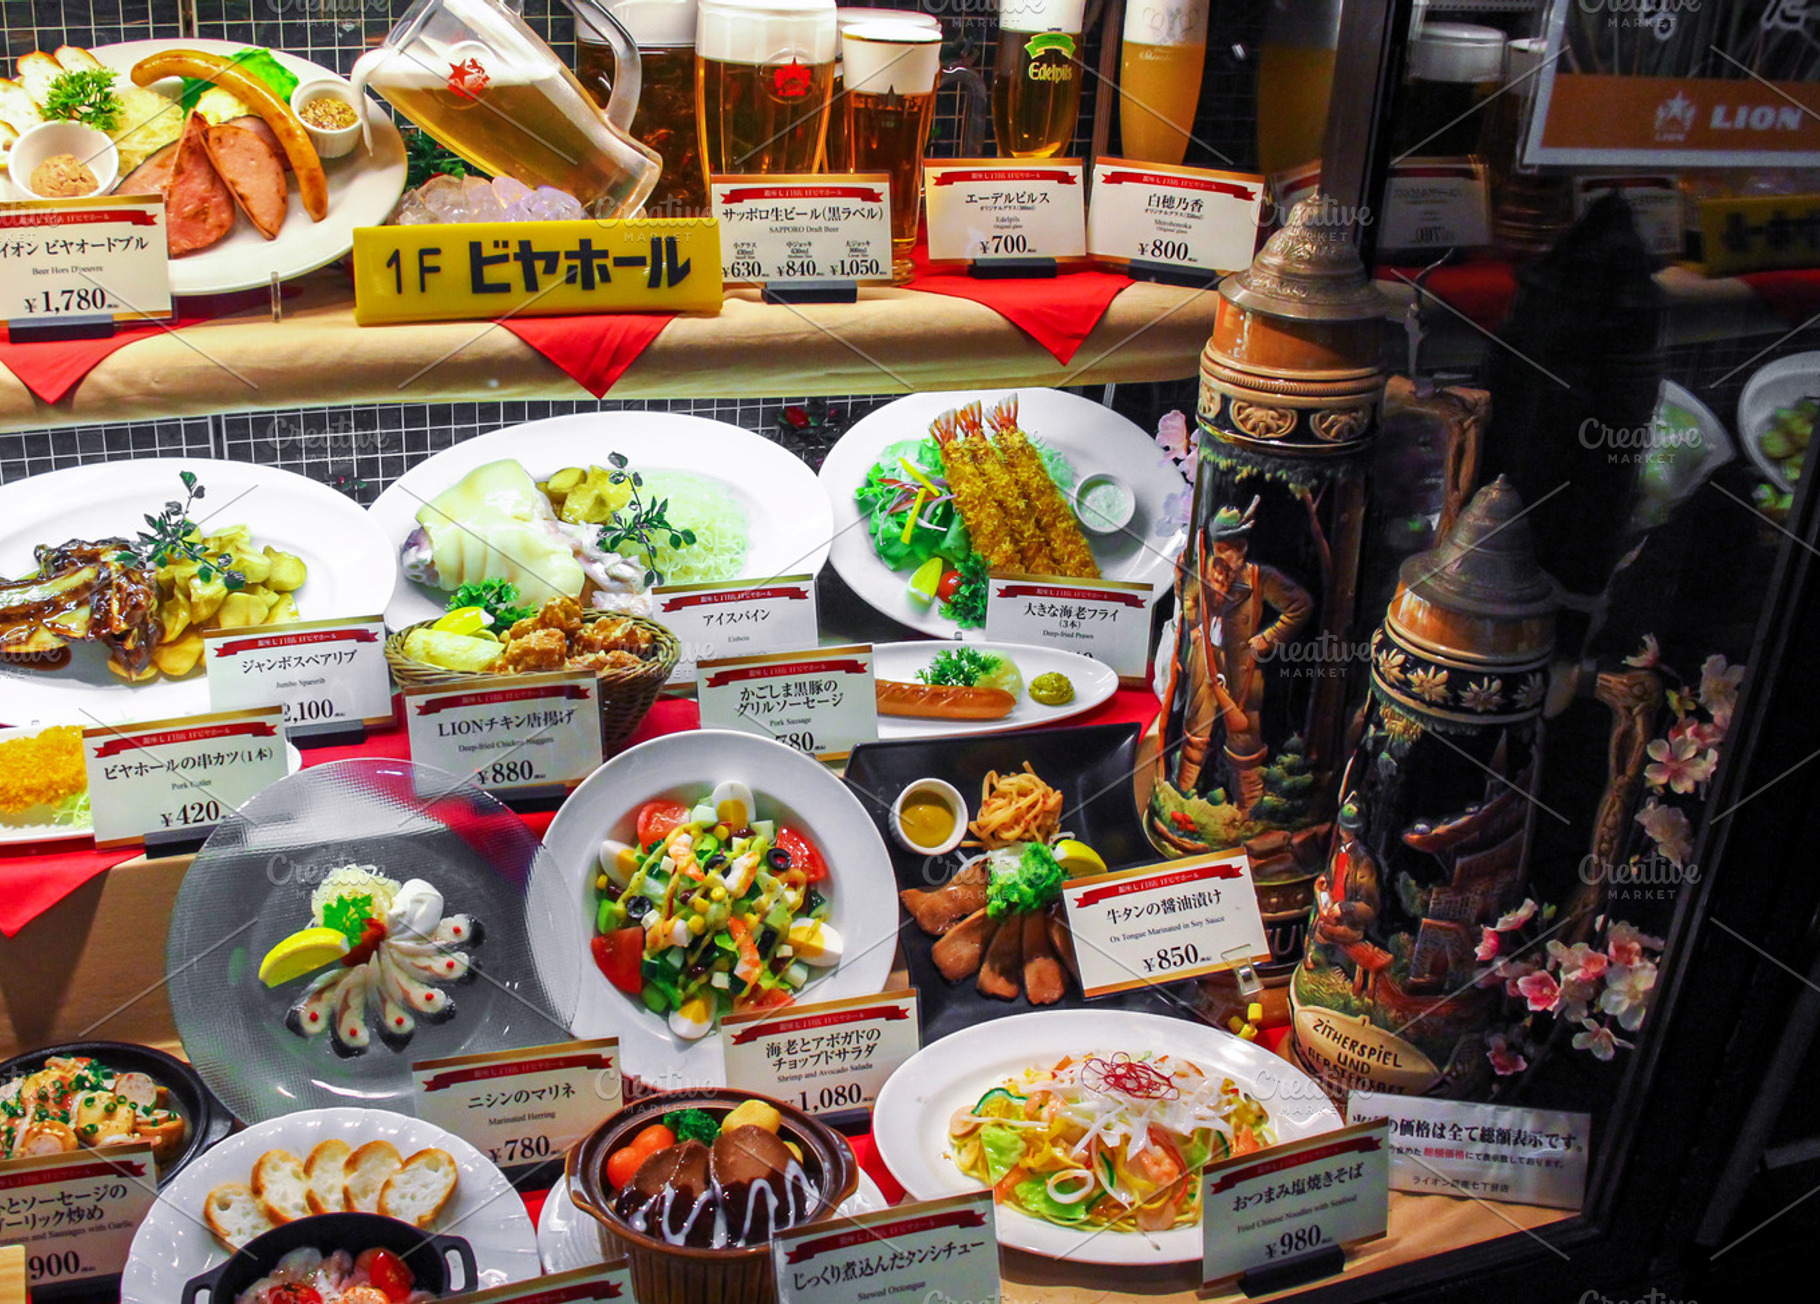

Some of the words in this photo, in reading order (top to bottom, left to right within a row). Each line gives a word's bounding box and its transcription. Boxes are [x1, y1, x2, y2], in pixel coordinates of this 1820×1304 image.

[1029, 62, 1072, 83] Edelpils
[1710, 104, 1803, 130] LION
[723, 206, 883, 222] サッポロ生ビール(黒ラベル)
[1148, 193, 1204, 213] 白穂乃香
[980, 235, 1027, 254] ¥700
[1138, 239, 1188, 260] ¥800
[32, 267, 49, 275] Beer
[51, 266, 69, 274] Hors
[386, 248, 441, 294] 1F
[469, 236, 691, 294] ビヤホール
[722, 261, 762, 278] ¥630
[777, 260, 816, 277] ¥840
[830, 259, 879, 276] ¥1,050
[24, 287, 106, 315] ¥1,780
[1024, 602, 1120, 622] 大きな海老フライ
[1059, 620, 1082, 629] (3本)
[242, 649, 357, 674] ジャンボスペアリブ
[276, 680, 297, 689] Jumbo
[740, 680, 838, 701] かごしま黒豚の
[737, 692, 844, 717] グリルソーセージ
[438, 708, 575, 737] LIONチキン唐揚げ
[104, 747, 274, 781] ビヤホールの串カツ(1本)
[477, 760, 533, 785] ¥880
[160, 800, 220, 827] ¥420
[1109, 935, 1121, 943] Ox
[1122, 931, 1146, 942] Tongue
[1147, 924, 1182, 936] Marinated
[1190, 919, 1204, 929] Soy
[1205, 916, 1225, 925] Sauce
[1143, 943, 1198, 973] ¥850
[765, 1028, 881, 1059] 海老とアボガドの
[772, 1043, 878, 1072] チョップドサラダ
[1337, 1053, 1371, 1075] UND
[777, 1074, 803, 1083] Shrimp
[819, 1066, 849, 1077] Avocado
[467, 1083, 576, 1109] ニシンのマリネ
[785, 1083, 861, 1113] 1,080
[489, 1115, 526, 1126] Marinated
[527, 1111, 556, 1121] Herring
[1353, 1115, 1583, 1153] の価格は全て総額表示です。
[489, 1135, 550, 1163] ¥780
[0, 1184, 127, 1215] とソーセージの
[1232, 1162, 1364, 1212] おつまみ塩焼きそば
[1257, 1215, 1284, 1229] Chinese
[1265, 1224, 1321, 1259] ¥980
[29, 1251, 80, 1280] 900
[793, 1241, 985, 1292] じっくり煮込んだタンシチュー
